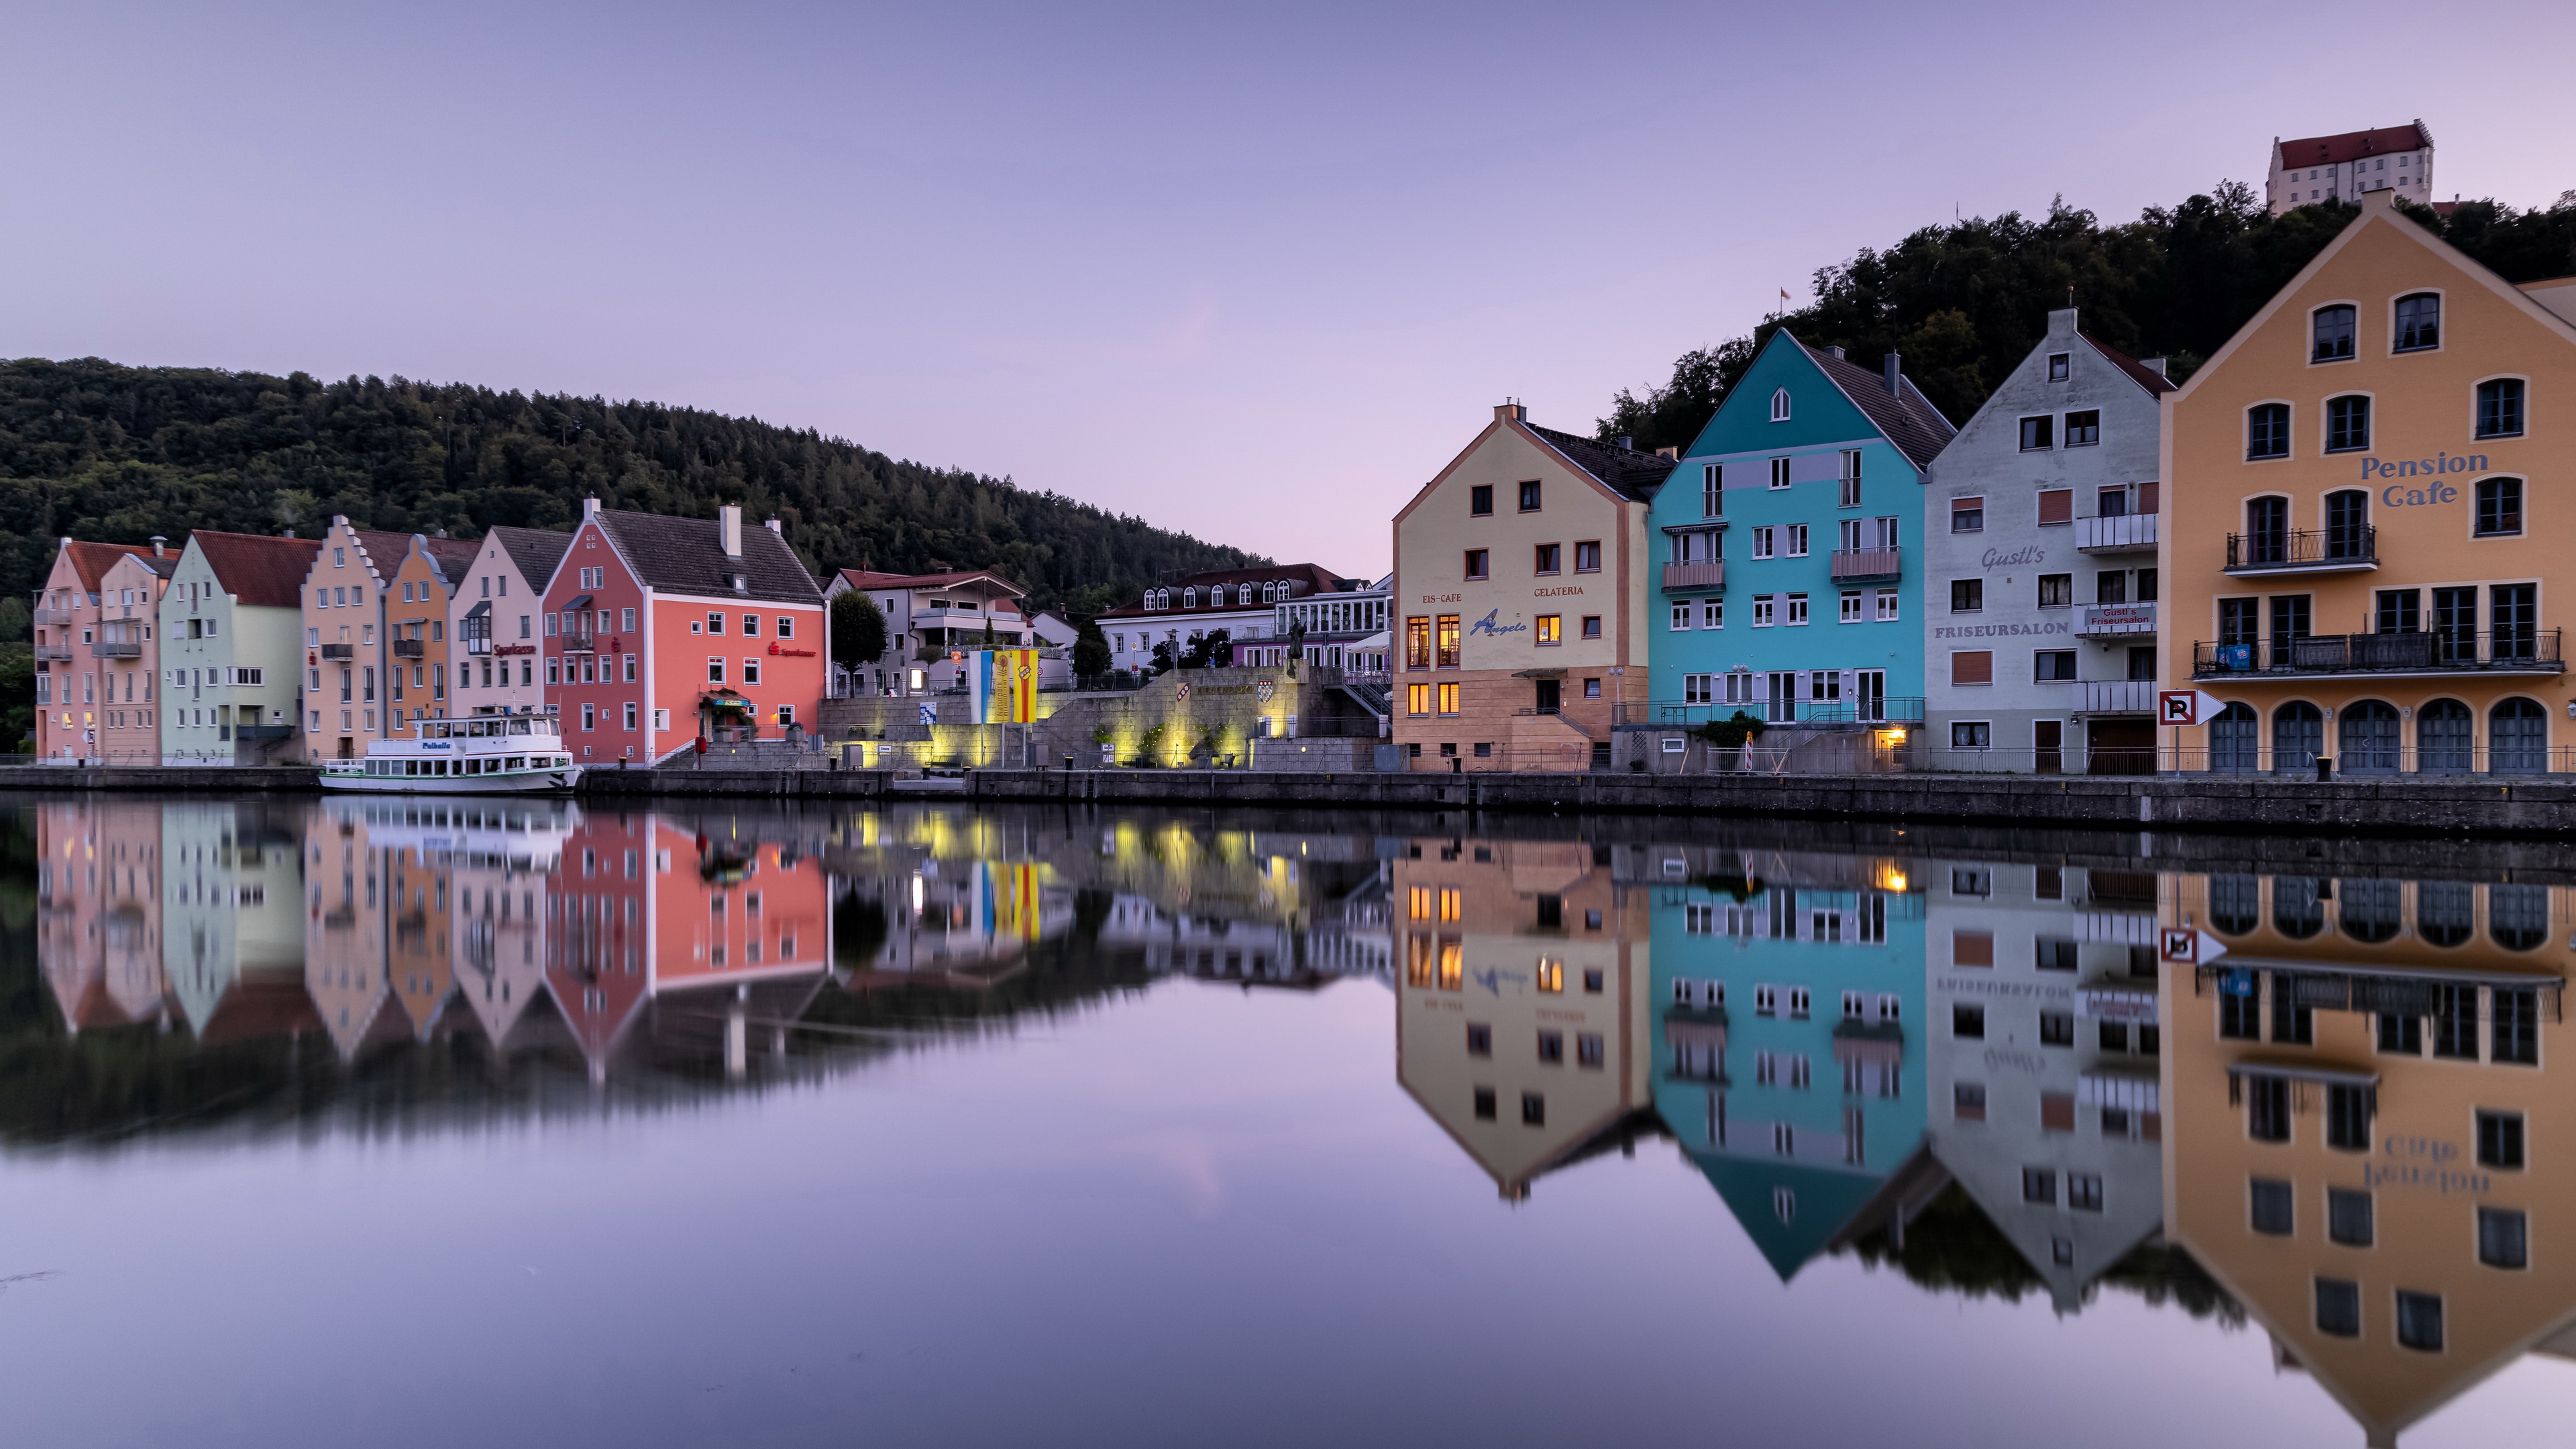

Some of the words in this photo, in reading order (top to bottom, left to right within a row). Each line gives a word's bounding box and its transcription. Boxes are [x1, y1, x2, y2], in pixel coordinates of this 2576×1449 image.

[2361, 451, 2488, 479] Pension
[2382, 481, 2457, 507] Cafe
[1982, 545, 2045, 573] Gustl's
[1422, 594, 1462, 604] EIS-CAFE
[1534, 586, 1584, 597] GELATERIA
[1470, 608, 1527, 637] Angelo
[1935, 623, 2068, 638] FRISEURSALON
[2092, 616, 2149, 625] Friseursalon
